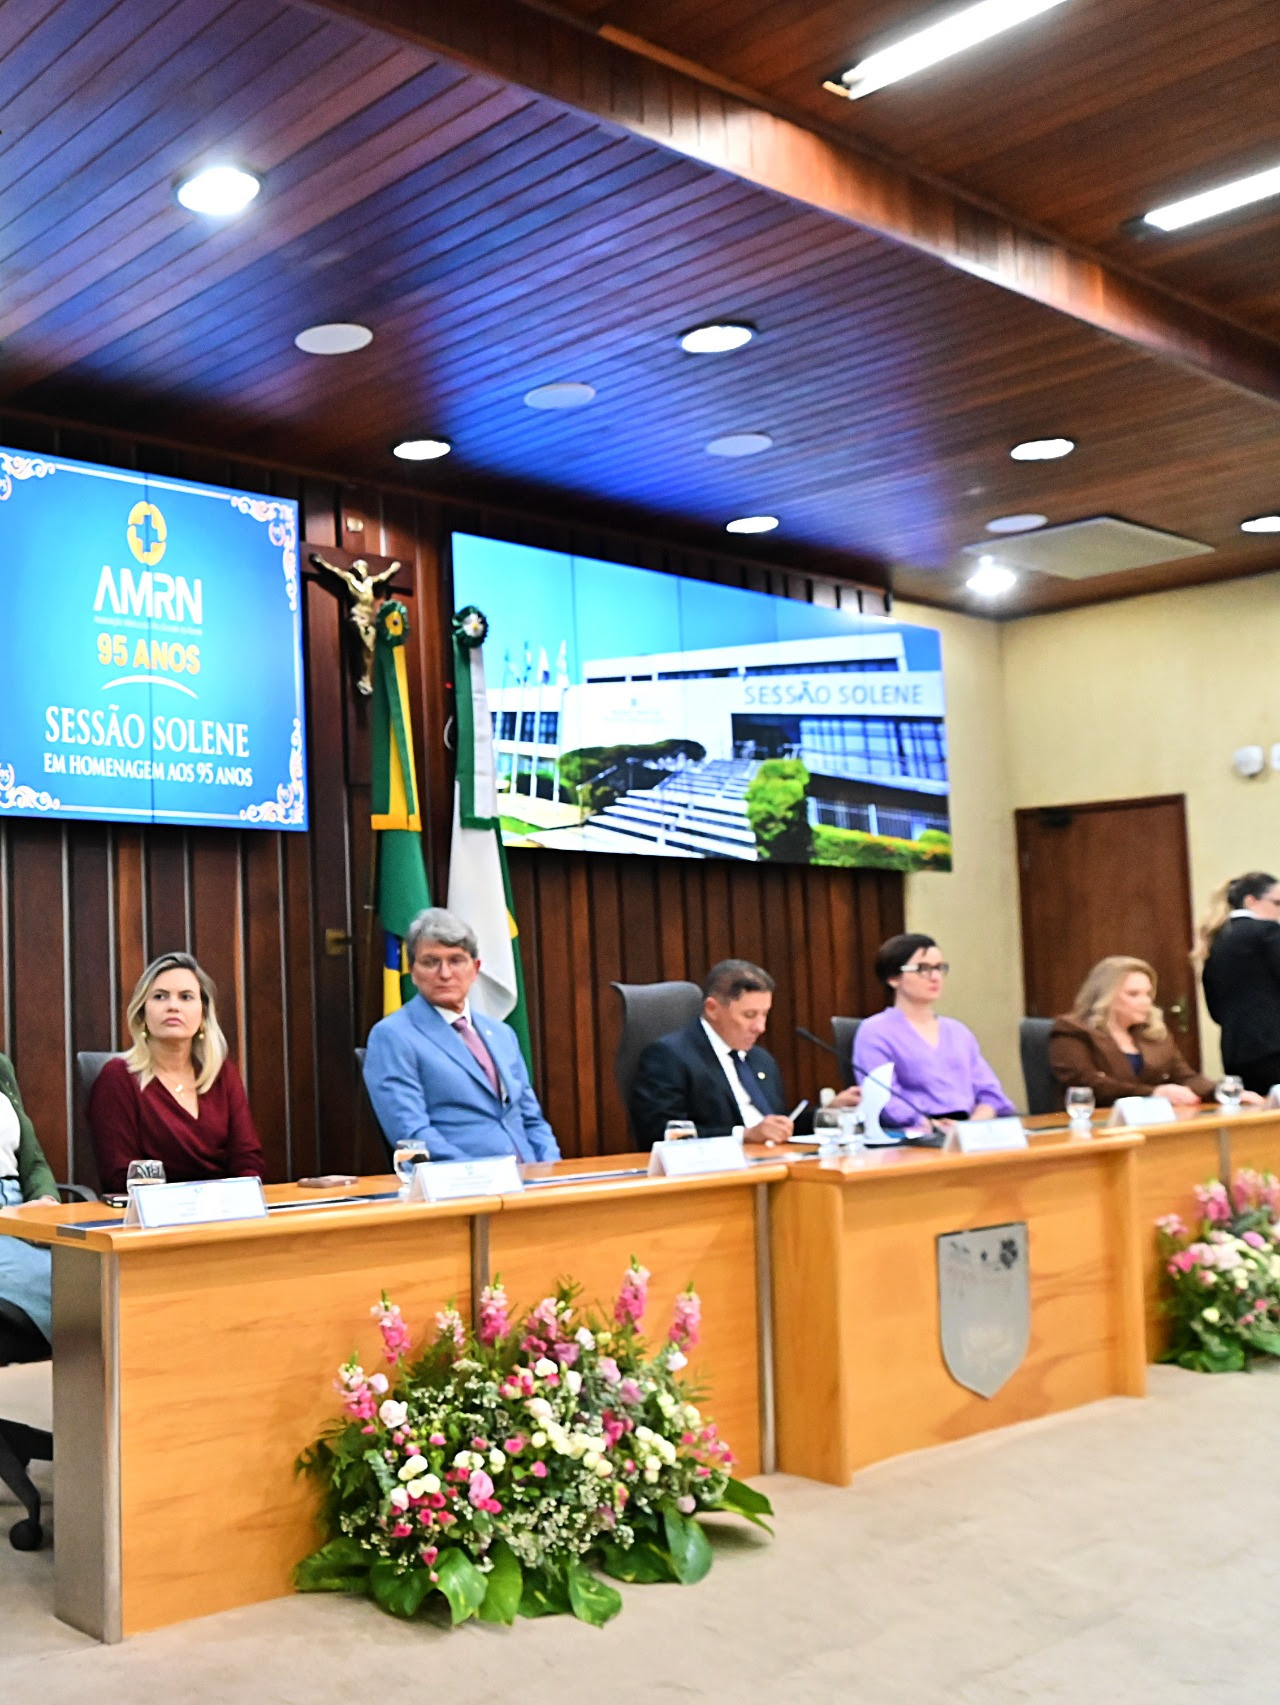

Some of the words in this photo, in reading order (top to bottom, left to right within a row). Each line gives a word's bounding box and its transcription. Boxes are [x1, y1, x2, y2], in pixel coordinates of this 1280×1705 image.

[93, 565, 202, 625] AMRN
[97, 632, 128, 667] 95
[133, 638, 200, 675] ANOS
[745, 681, 831, 704] SESSÃO
[838, 684, 923, 704] SOLENE
[45, 704, 145, 749] SESSÃO
[152, 715, 250, 758] SOLENE
[43, 752, 66, 774] EM
[69, 754, 165, 781] HOMENAGEM
[167, 762, 195, 783] AOS
[196, 761, 214, 784] 95
[215, 766, 253, 787] ANOS
